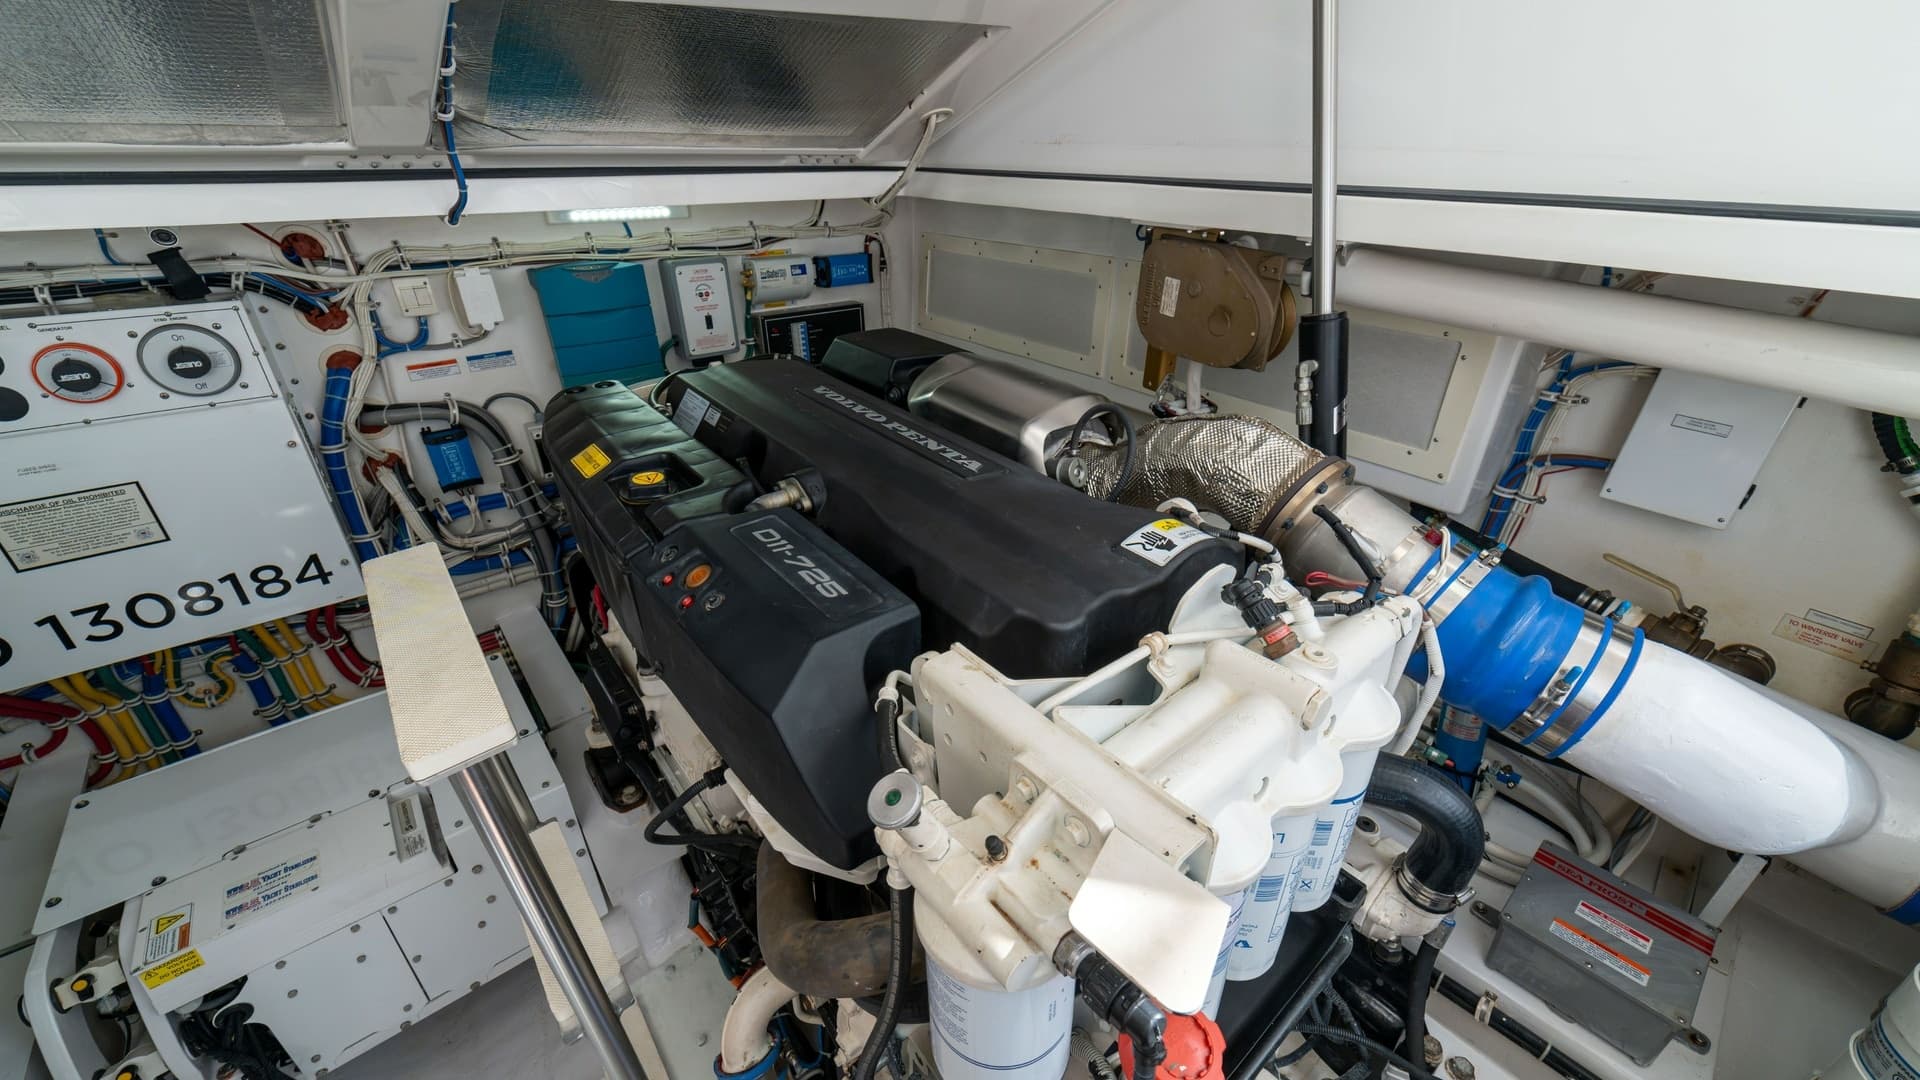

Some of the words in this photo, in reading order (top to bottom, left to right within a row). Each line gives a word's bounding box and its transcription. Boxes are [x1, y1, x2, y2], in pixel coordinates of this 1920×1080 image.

[195, 382, 208, 390] Off
[812, 385, 887, 423] VOLVO
[881, 421, 984, 473] PENTA
[48, 500, 61, 508] OF
[62, 497, 77, 506] OIL
[78, 489, 126, 502] PROHIBITED
[751, 527, 848, 600] D11-725
[34, 552, 333, 651] 1308184
[1789, 619, 1800, 627] TO
[1557, 862, 1585, 882] SEA
[1586, 879, 1636, 908] FROST
